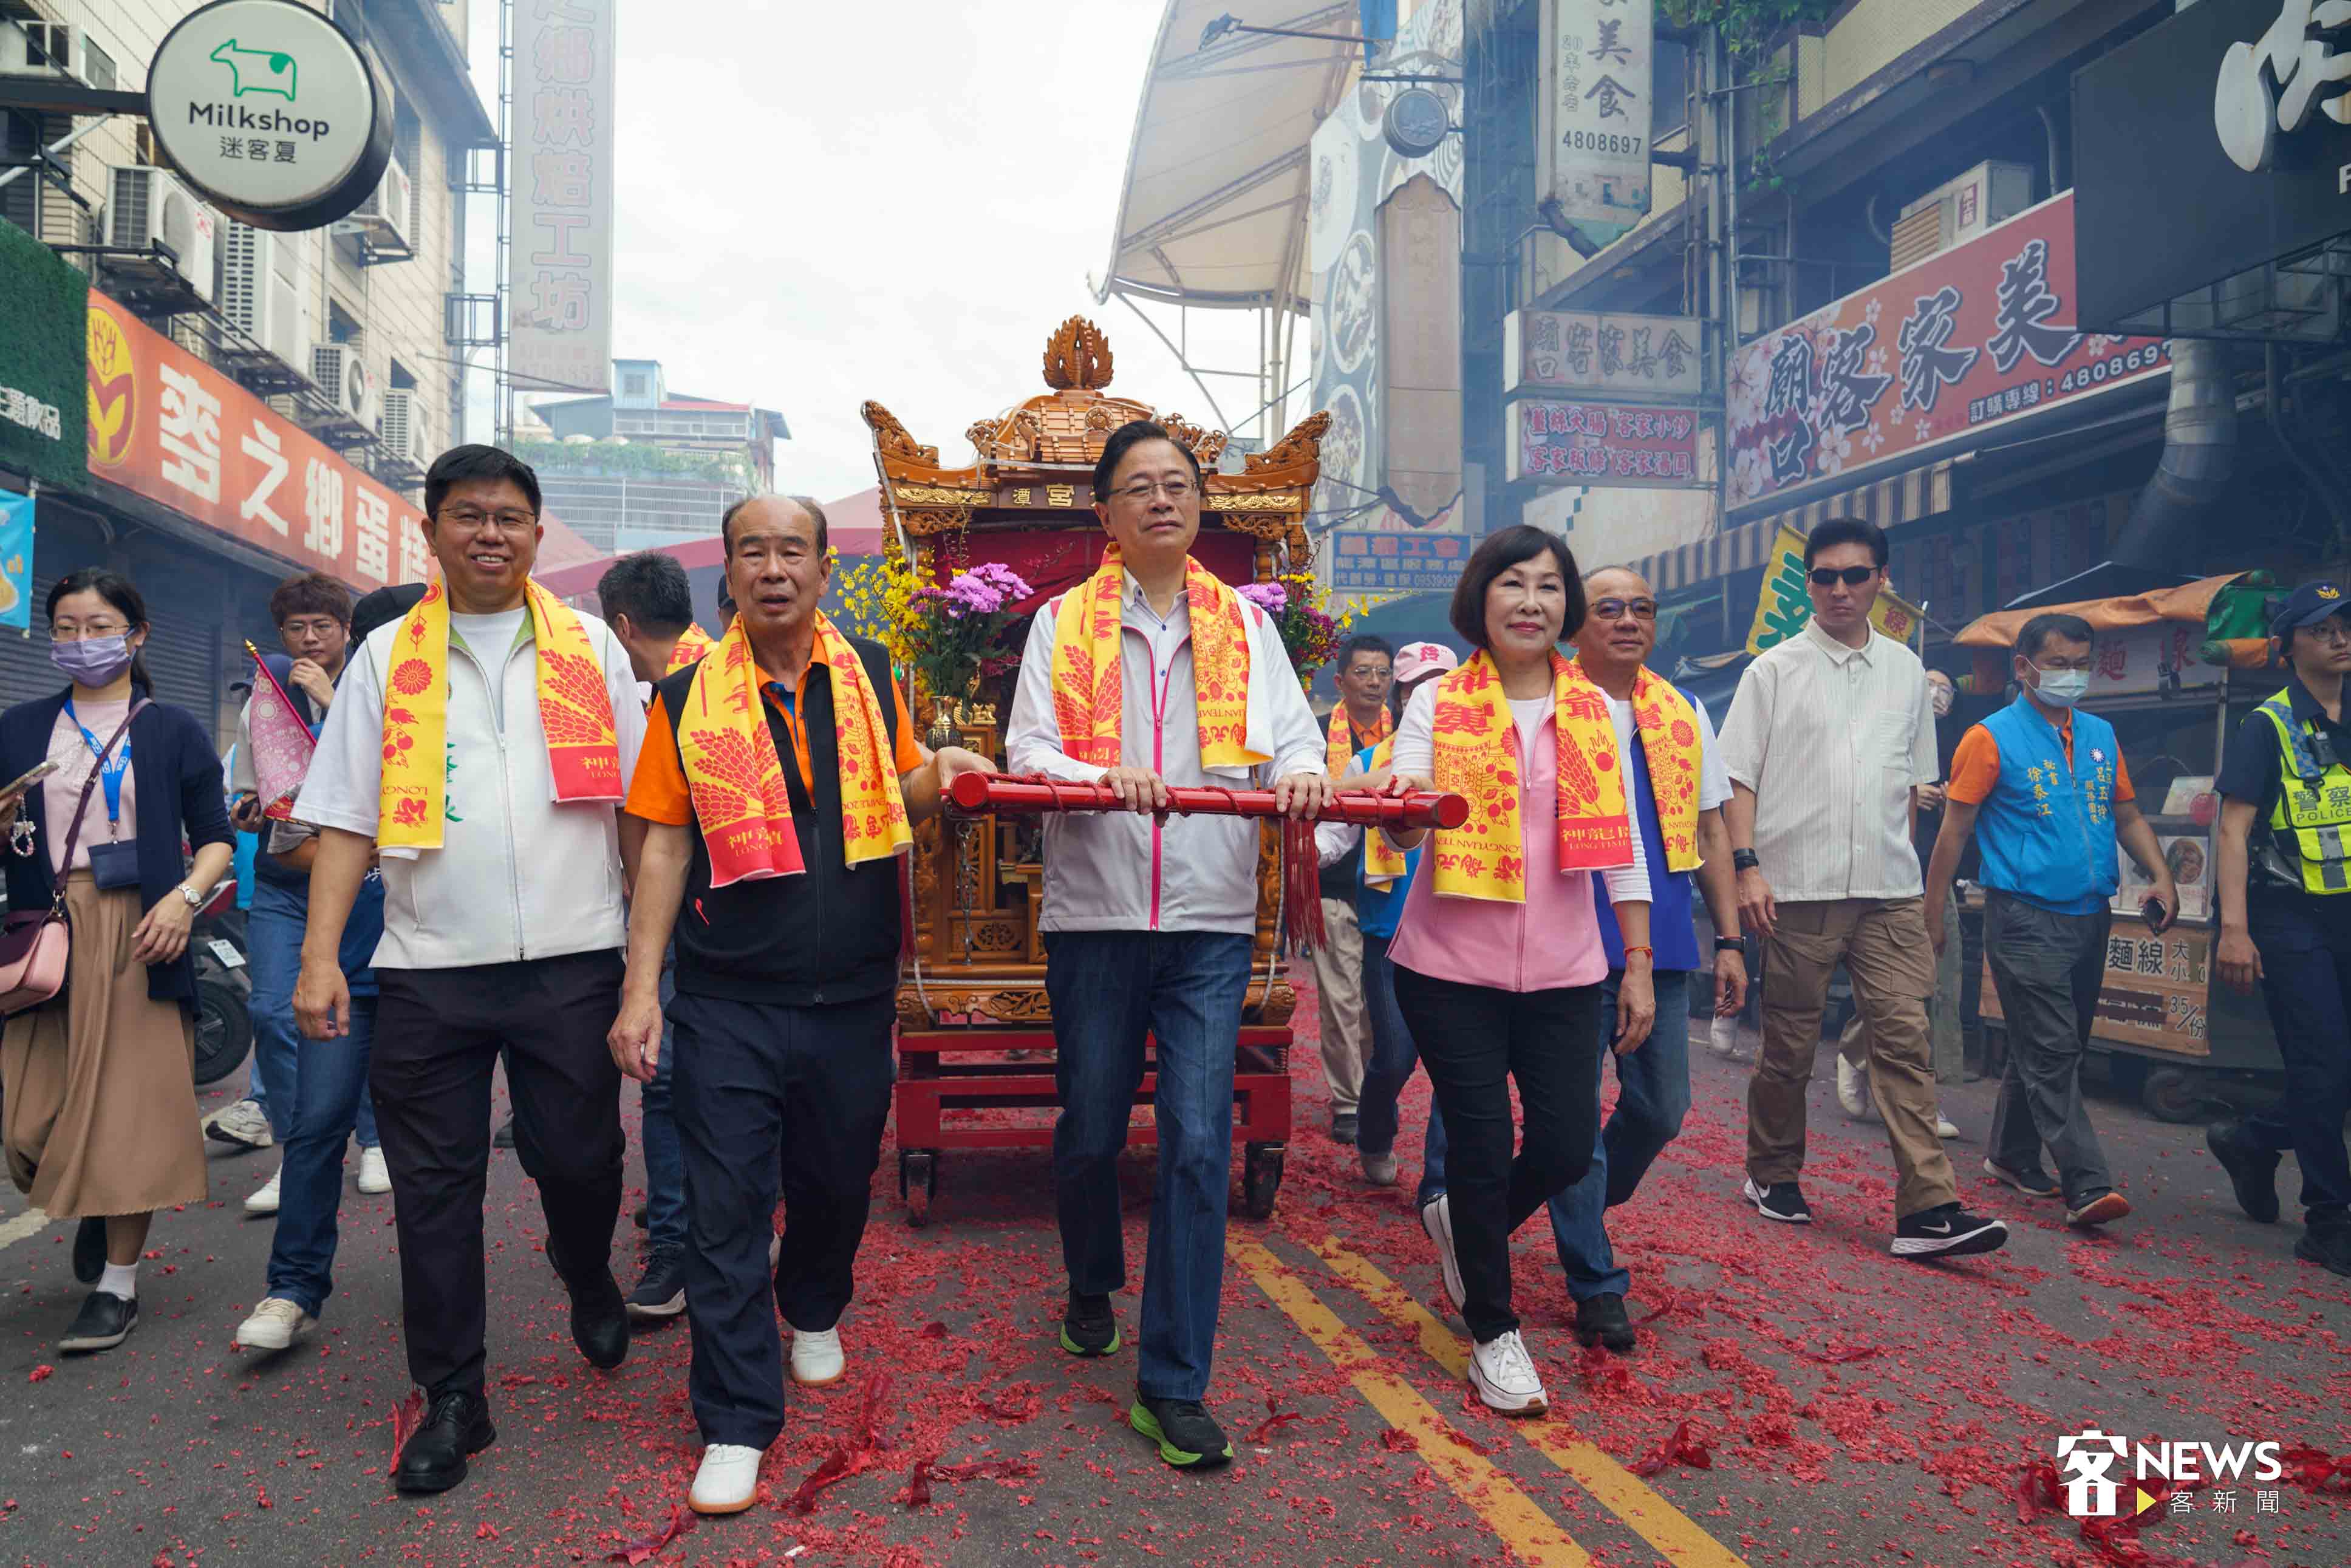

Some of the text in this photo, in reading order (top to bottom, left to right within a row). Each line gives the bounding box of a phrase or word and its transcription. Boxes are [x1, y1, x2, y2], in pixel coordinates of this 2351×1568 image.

[1583, 0, 1636, 120] 美食
[189, 101, 330, 141] Milkshop
[219, 135, 297, 165] 迷客夏
[1562, 130, 1642, 155] 4808697
[1761, 238, 2083, 486] 廟口客家美
[2296, 806, 2351, 822] POLICE
[2107, 937, 2164, 974] 麵線
